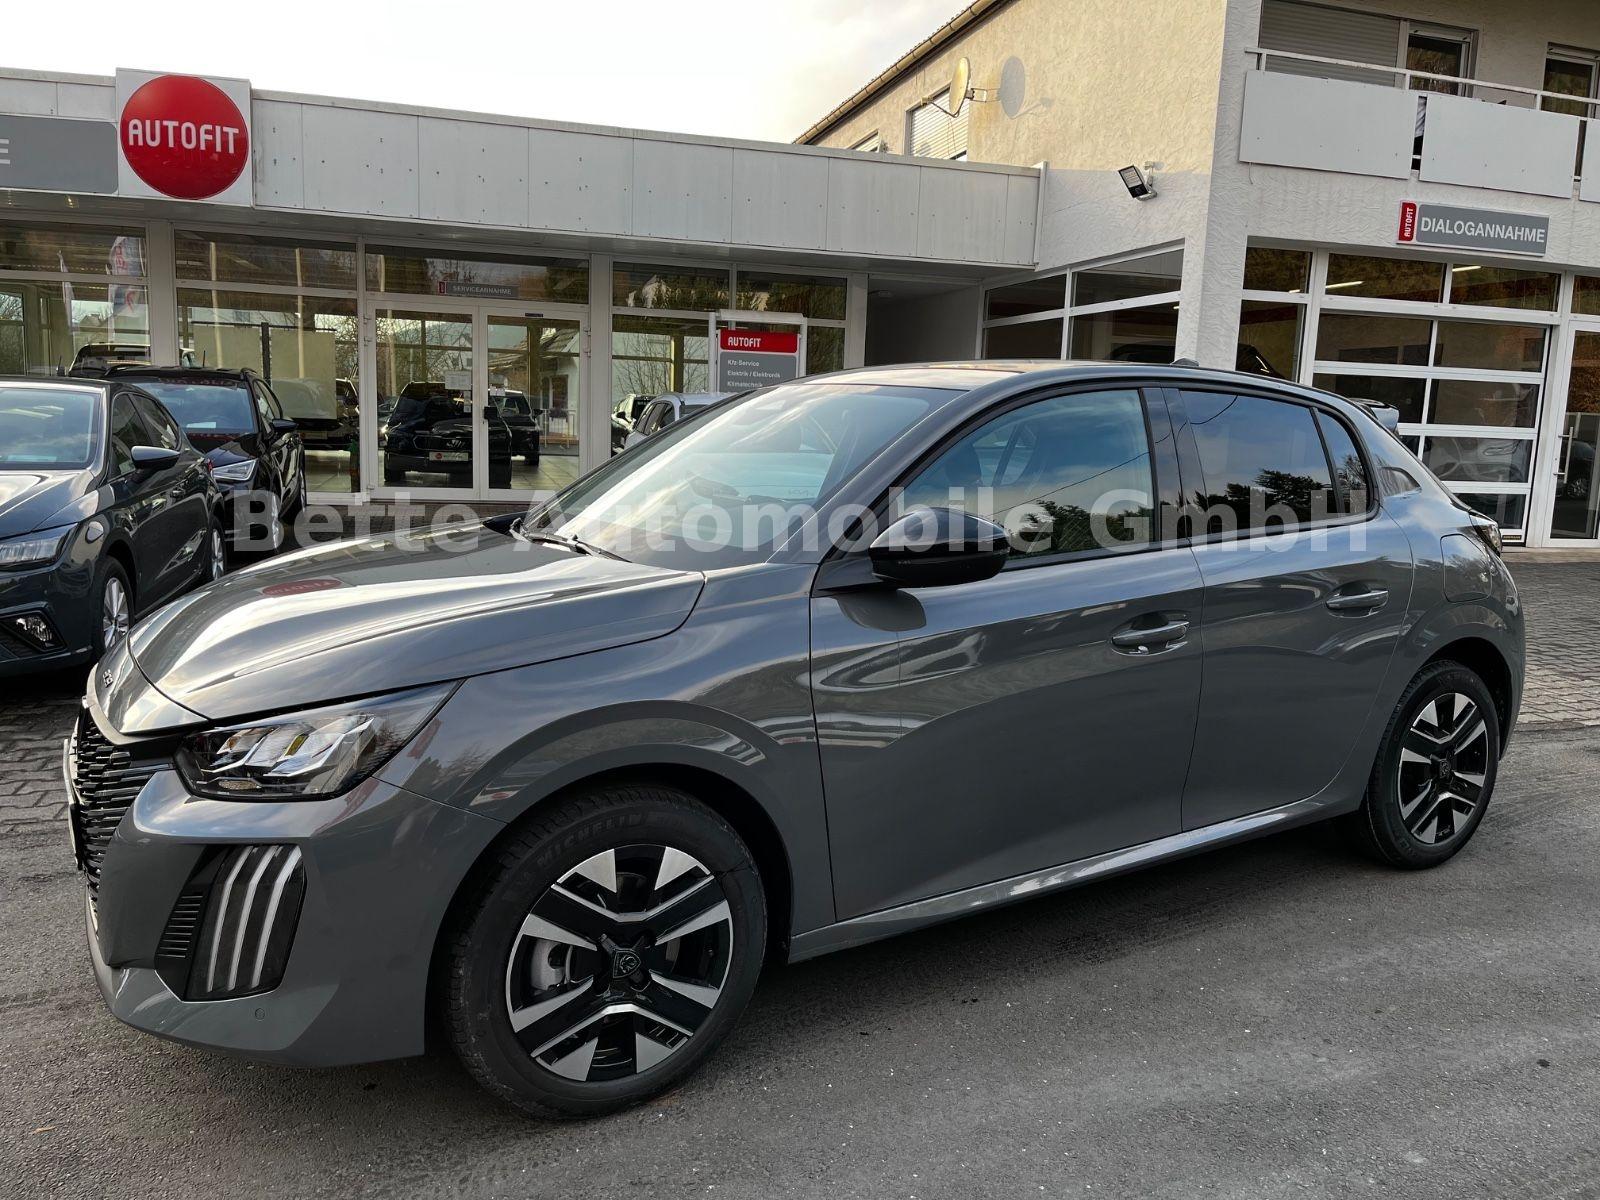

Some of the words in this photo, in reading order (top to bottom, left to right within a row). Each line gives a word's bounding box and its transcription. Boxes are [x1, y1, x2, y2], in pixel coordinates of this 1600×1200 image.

[128, 119, 239, 154] AUTOFIT
[1403, 207, 1414, 237] AUTOFIT
[1420, 217, 1546, 243] DIALOGANNAHME
[452, 285, 512, 295] SERVICEANNAHME
[728, 336, 761, 348] AUTOFIT
